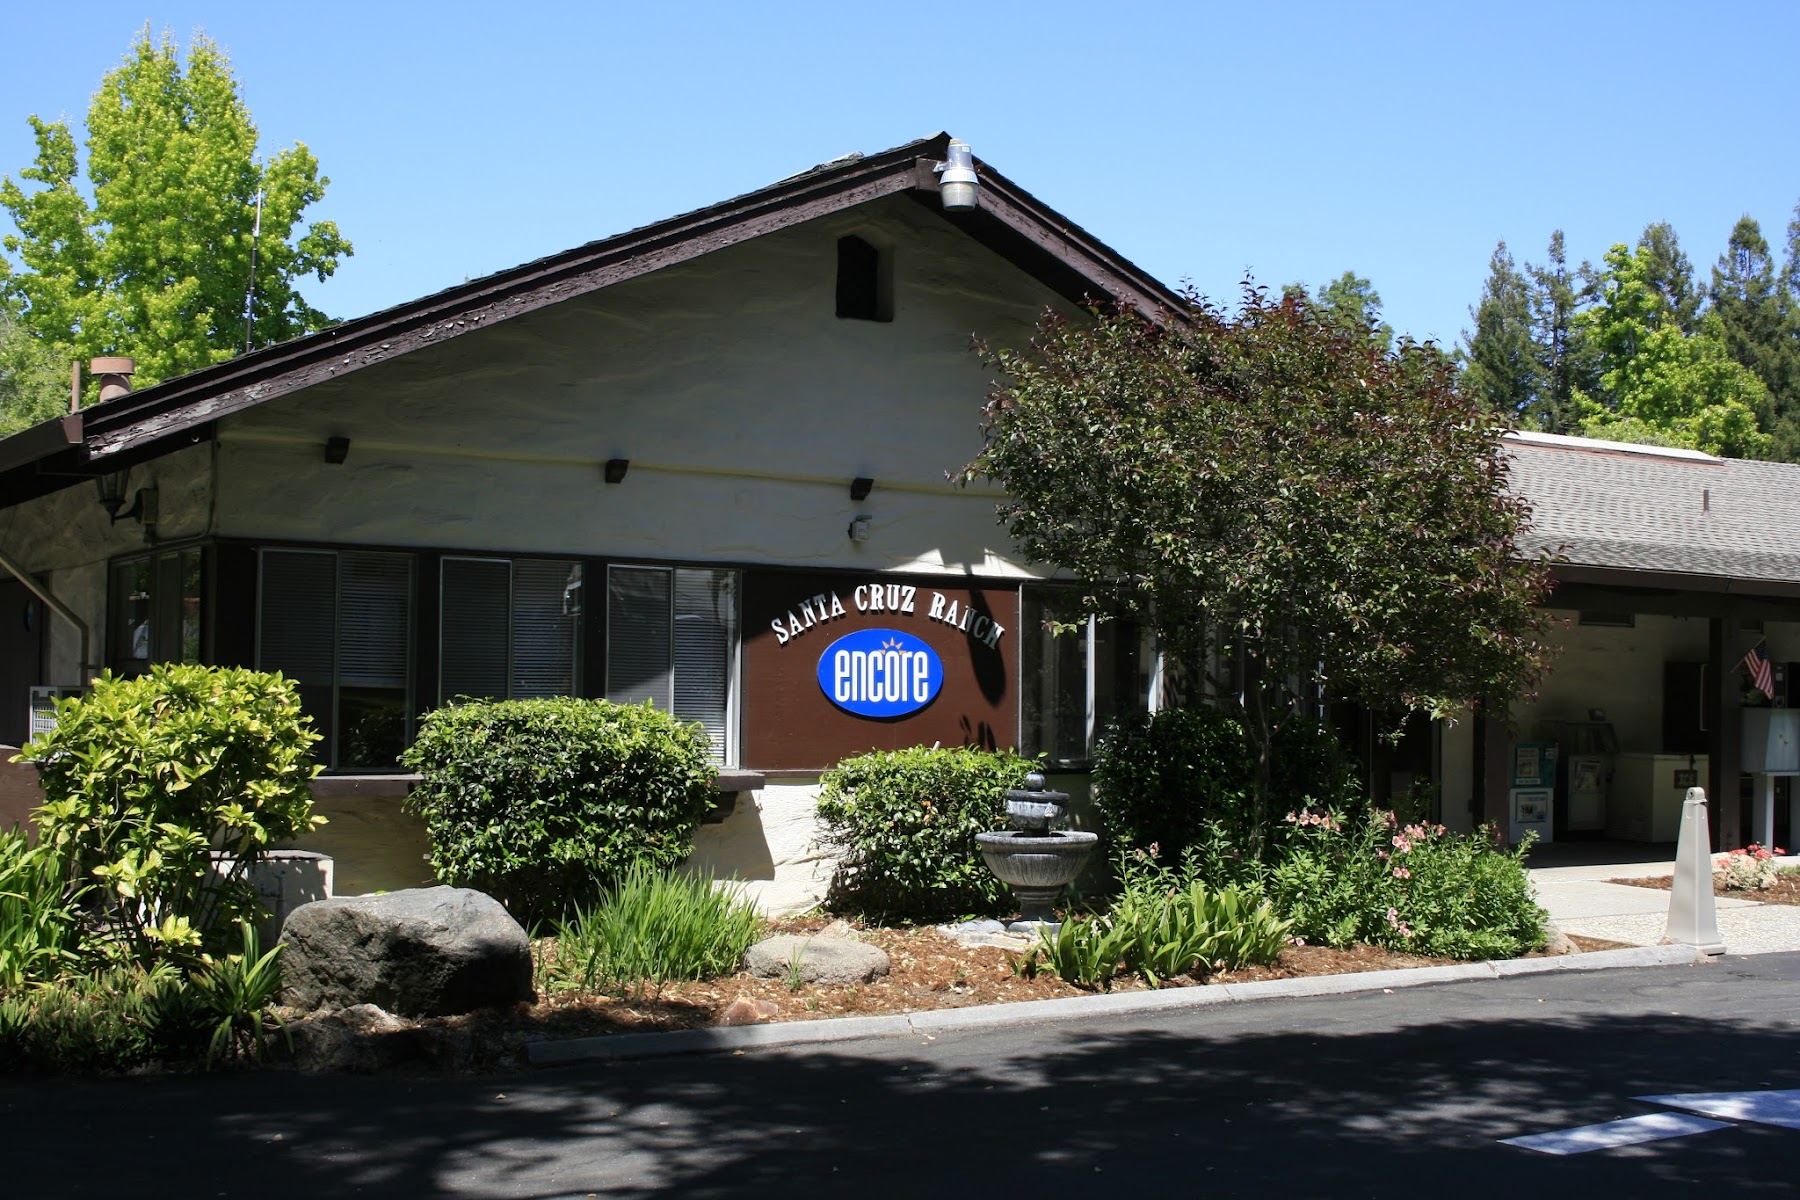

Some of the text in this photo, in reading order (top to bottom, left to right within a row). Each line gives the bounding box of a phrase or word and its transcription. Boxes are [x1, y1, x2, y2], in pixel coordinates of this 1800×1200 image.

[771, 583, 1006, 650] SANTA CRUZ RANCH
[834, 649, 929, 703] encore
